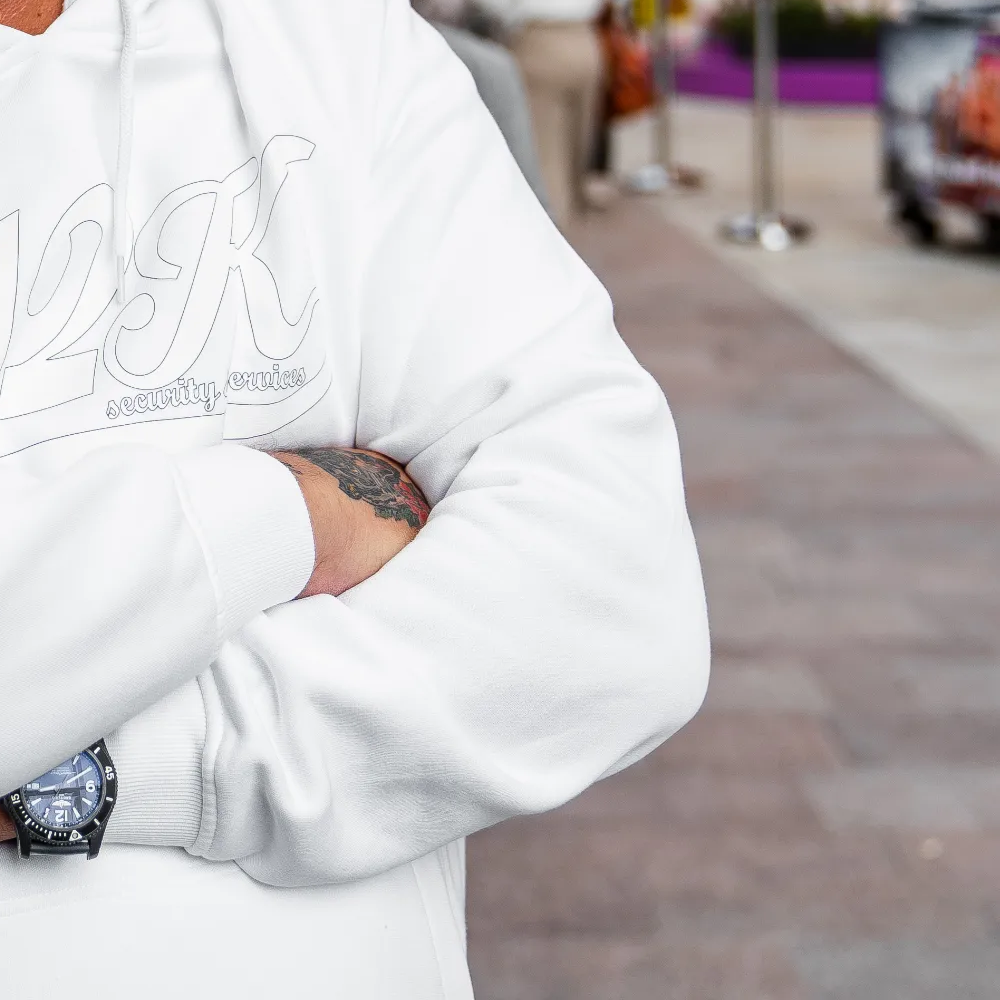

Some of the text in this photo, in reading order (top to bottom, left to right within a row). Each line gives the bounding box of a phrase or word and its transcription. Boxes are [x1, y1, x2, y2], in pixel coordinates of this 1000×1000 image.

[106, 363, 306, 419] security ervices
[104, 765, 115, 781] 45
[85, 780, 96, 793] 9
[10, 793, 21, 805] 15
[54, 809, 69, 823] 12
